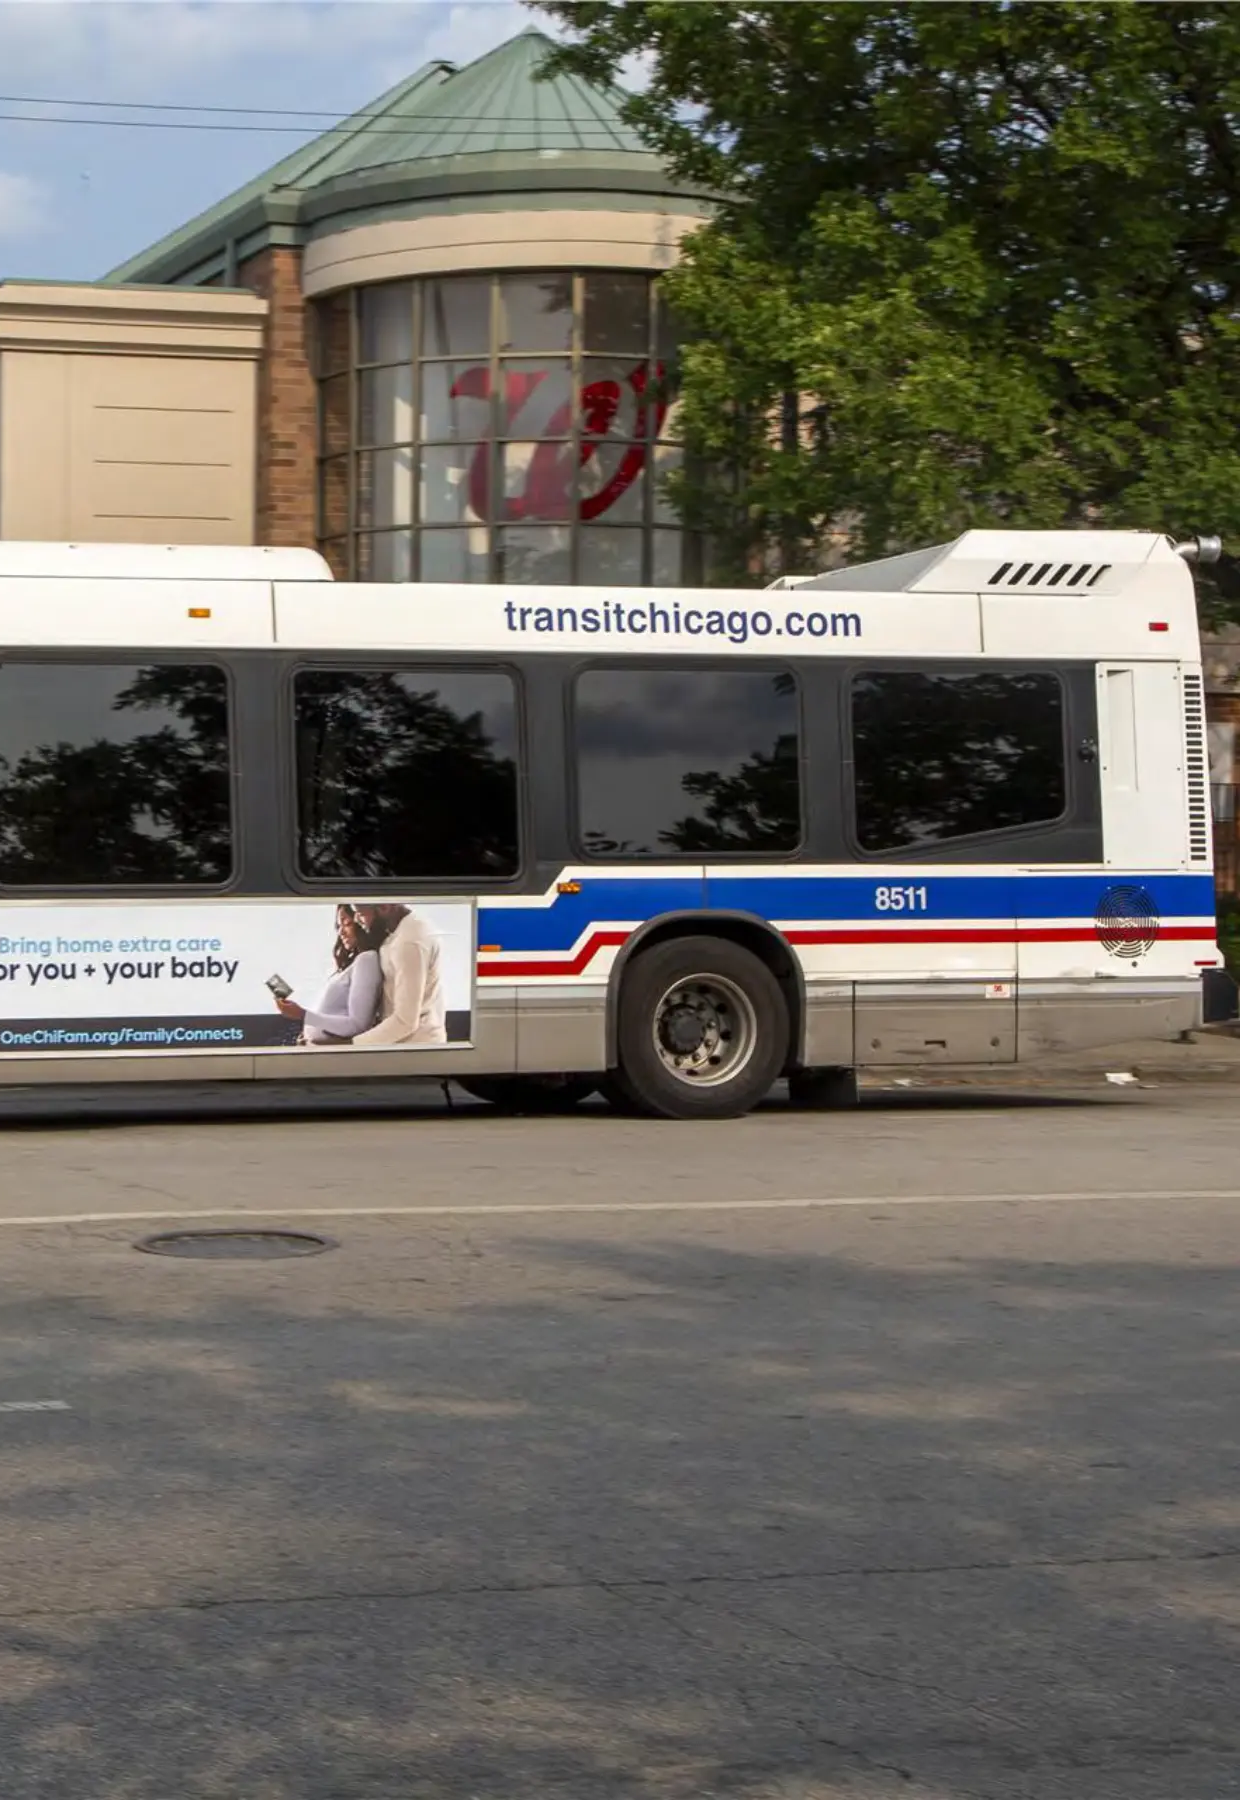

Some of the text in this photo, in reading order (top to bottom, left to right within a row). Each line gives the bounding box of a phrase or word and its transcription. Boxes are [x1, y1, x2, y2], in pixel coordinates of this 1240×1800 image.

[504, 601, 861, 643] transitchicago.com
[875, 886, 927, 911] 8511
[57, 937, 113, 954] home
[118, 938, 171, 953] extra
[176, 937, 221, 951] care
[27, 963, 77, 985] you
[104, 962, 164, 984] your
[170, 956, 239, 983] baby
[0, 1026, 244, 1045] OneChiFam.org/FamilyConnects
